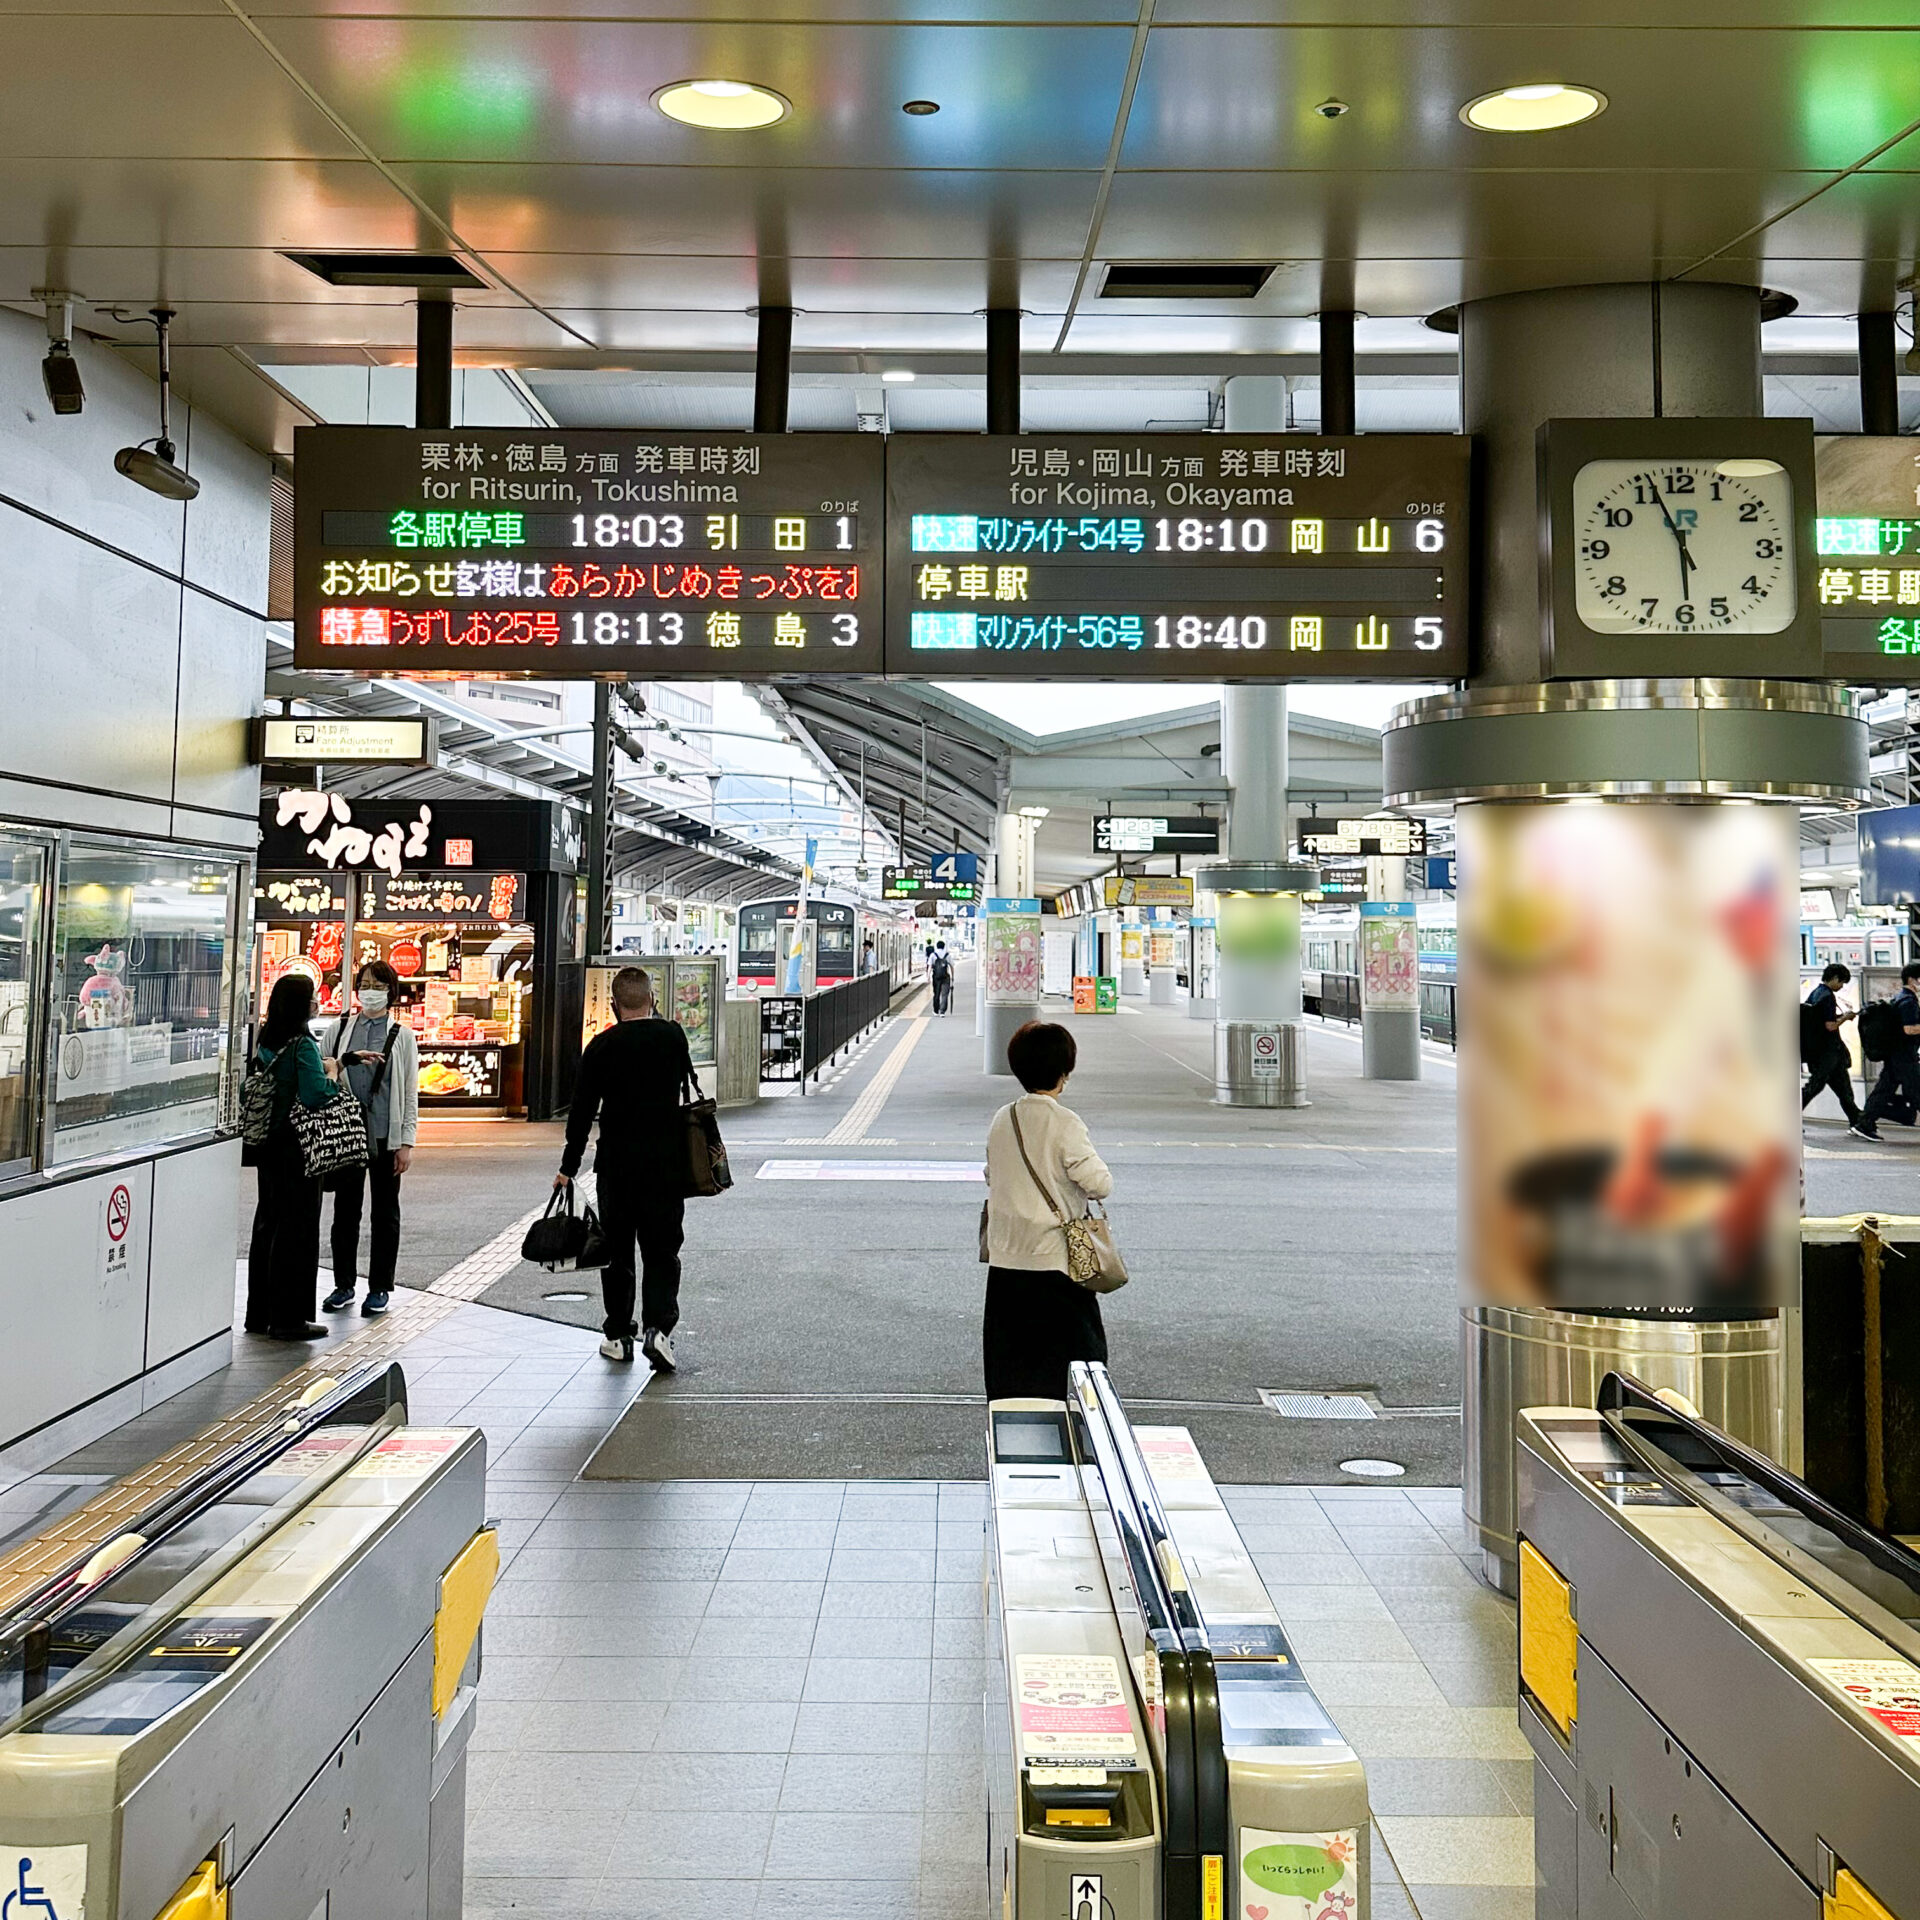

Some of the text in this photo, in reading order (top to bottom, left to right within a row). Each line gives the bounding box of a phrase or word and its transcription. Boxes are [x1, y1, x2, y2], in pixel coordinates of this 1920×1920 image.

[421, 442, 761, 475] 栗林・徳島 方面 発車時刻
[1010, 449, 1346, 478] 児島・岡山 方面 発車時刻
[422, 478, 738, 505] for Ritsurin, Tokushima
[1665, 475, 1696, 494] 12
[1710, 482, 1723, 501] 1
[820, 500, 859, 513] のりば
[1010, 483, 1294, 510] for Kojima, Okayama
[1406, 502, 1446, 515] のりば
[1604, 508, 1633, 527] 10
[1739, 503, 1759, 522] 2
[390, 512, 525, 548] 各駅停車
[571, 515, 684, 548] 18:03
[836, 516, 853, 550] 1
[1154, 520, 1268, 552] 18:10
[1415, 520, 1443, 552] 6
[1590, 540, 1610, 560] 9
[1755, 539, 1775, 559] 3
[917, 565, 1029, 601] 停車駅
[1607, 576, 1627, 596] 8
[1742, 576, 1762, 594] 4
[1641, 598, 1659, 618] 7
[1676, 605, 1695, 624] 6
[1710, 597, 1729, 617] 5
[571, 611, 684, 645] 18:13
[832, 614, 858, 647] 3
[1154, 617, 1266, 649] 18:40
[1415, 617, 1442, 650] 5
[1878, 617, 1920, 654] 各
[316, 736, 393, 746] Fare Adjustment
[935, 856, 957, 881] 4
[826, 910, 845, 921] JR
[958, 906, 968, 917] 4
